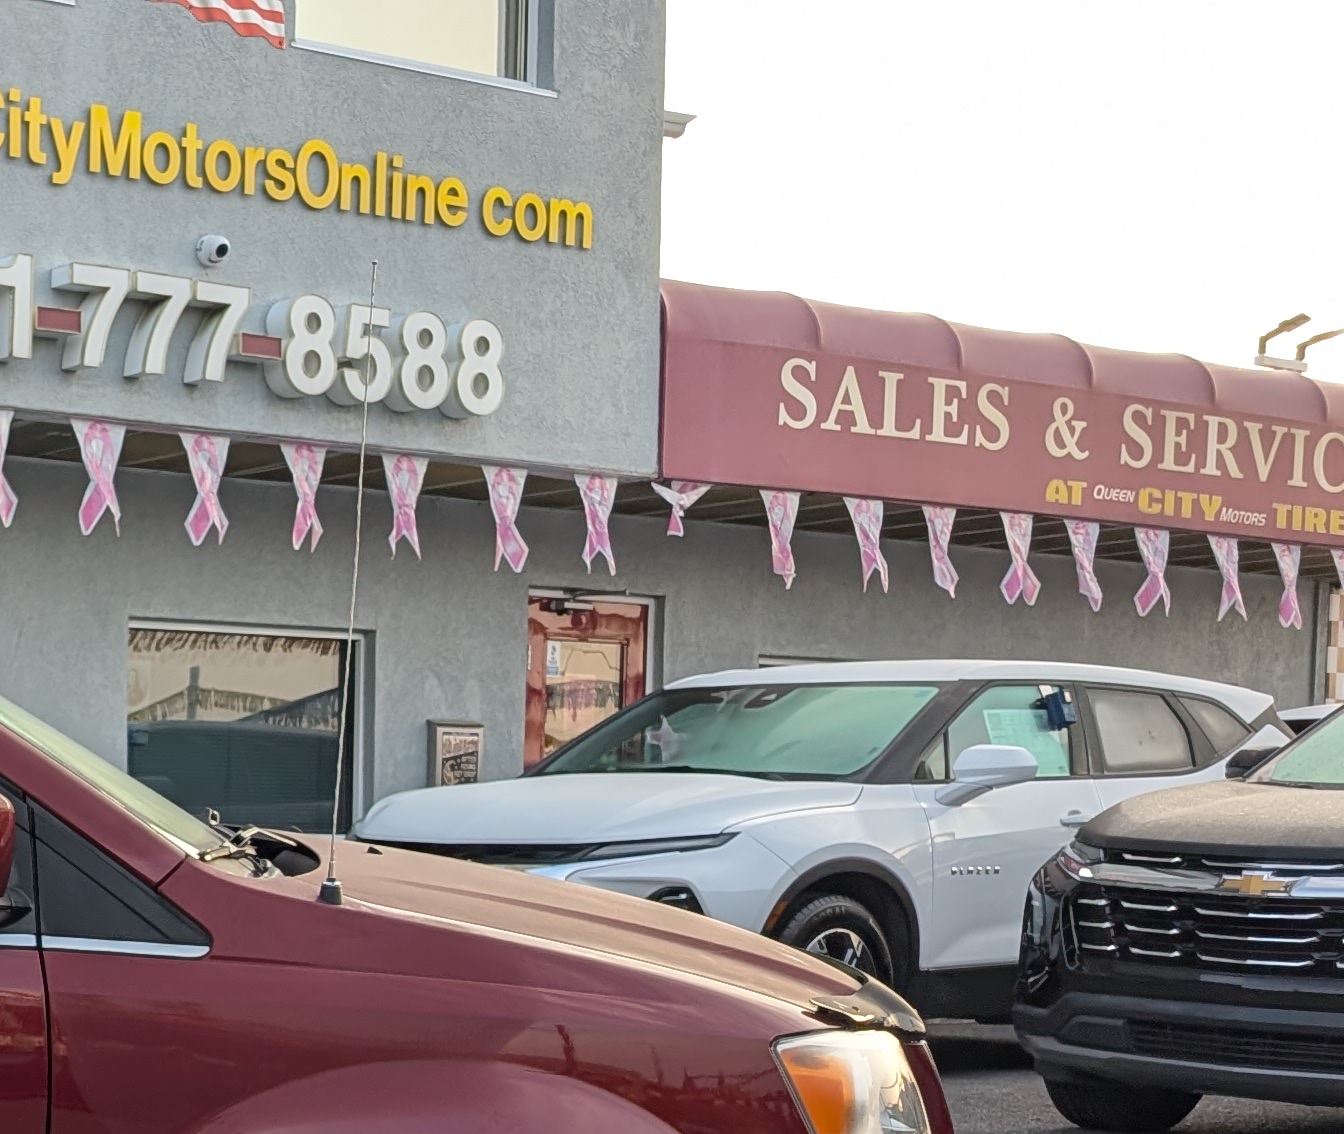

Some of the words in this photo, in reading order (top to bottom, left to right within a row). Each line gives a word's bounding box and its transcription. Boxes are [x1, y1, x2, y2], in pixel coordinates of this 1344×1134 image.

[778, 358, 1010, 452] SALES
[1045, 397, 1090, 461] &
[1045, 479, 1087, 506] AT
[1093, 484, 1135, 503] QUEEN
[1138, 487, 1222, 521] CITY
[1220, 507, 1267, 527] MOTORS
